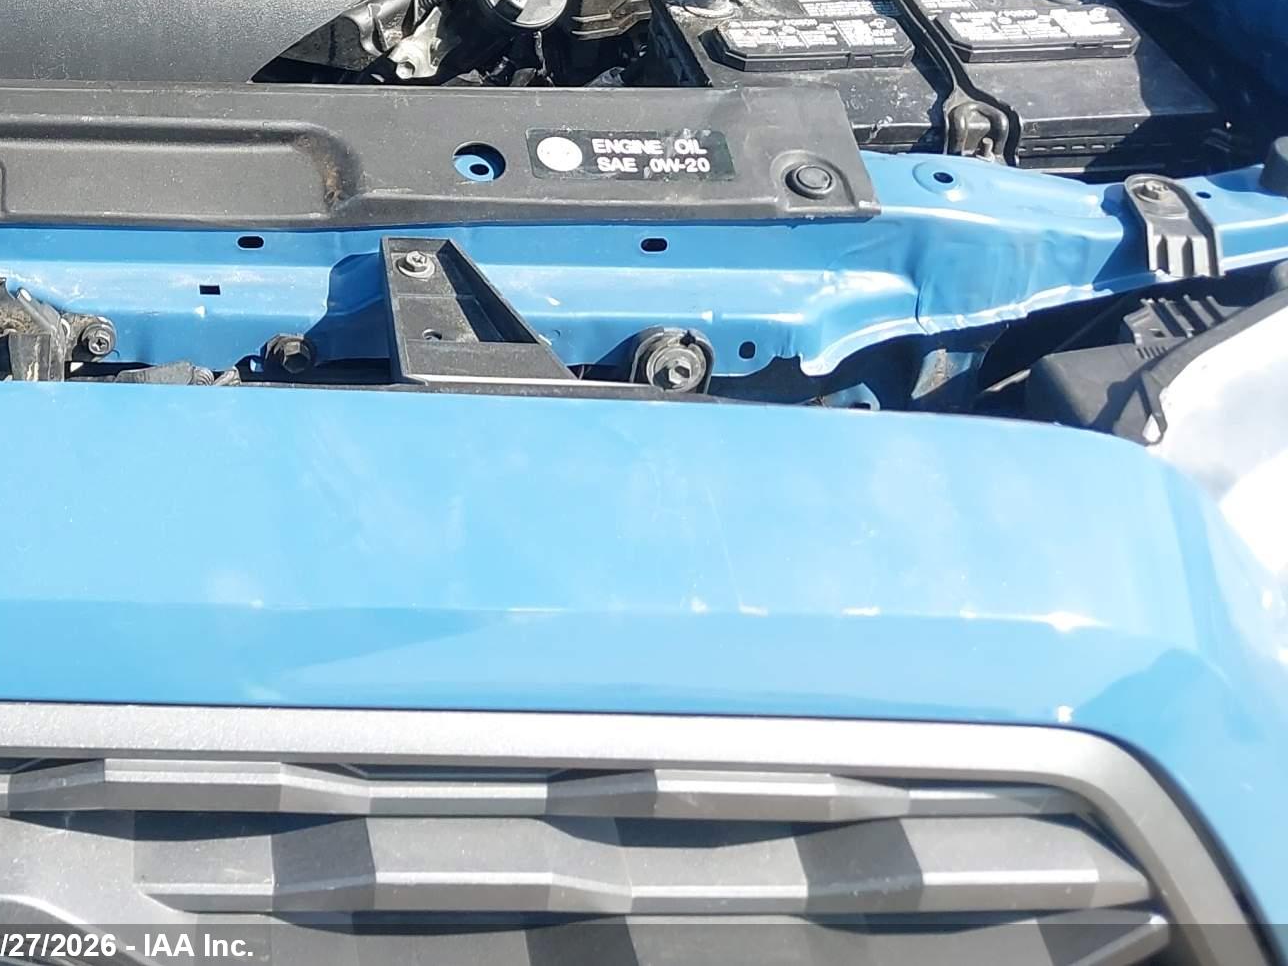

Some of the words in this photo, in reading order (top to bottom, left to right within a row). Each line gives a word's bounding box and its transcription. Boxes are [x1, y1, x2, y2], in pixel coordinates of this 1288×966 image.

[592, 138, 664, 154] ENGINE
[674, 138, 708, 155] OIL
[596, 156, 639, 172] SAE
[649, 157, 711, 173] 0W-20
